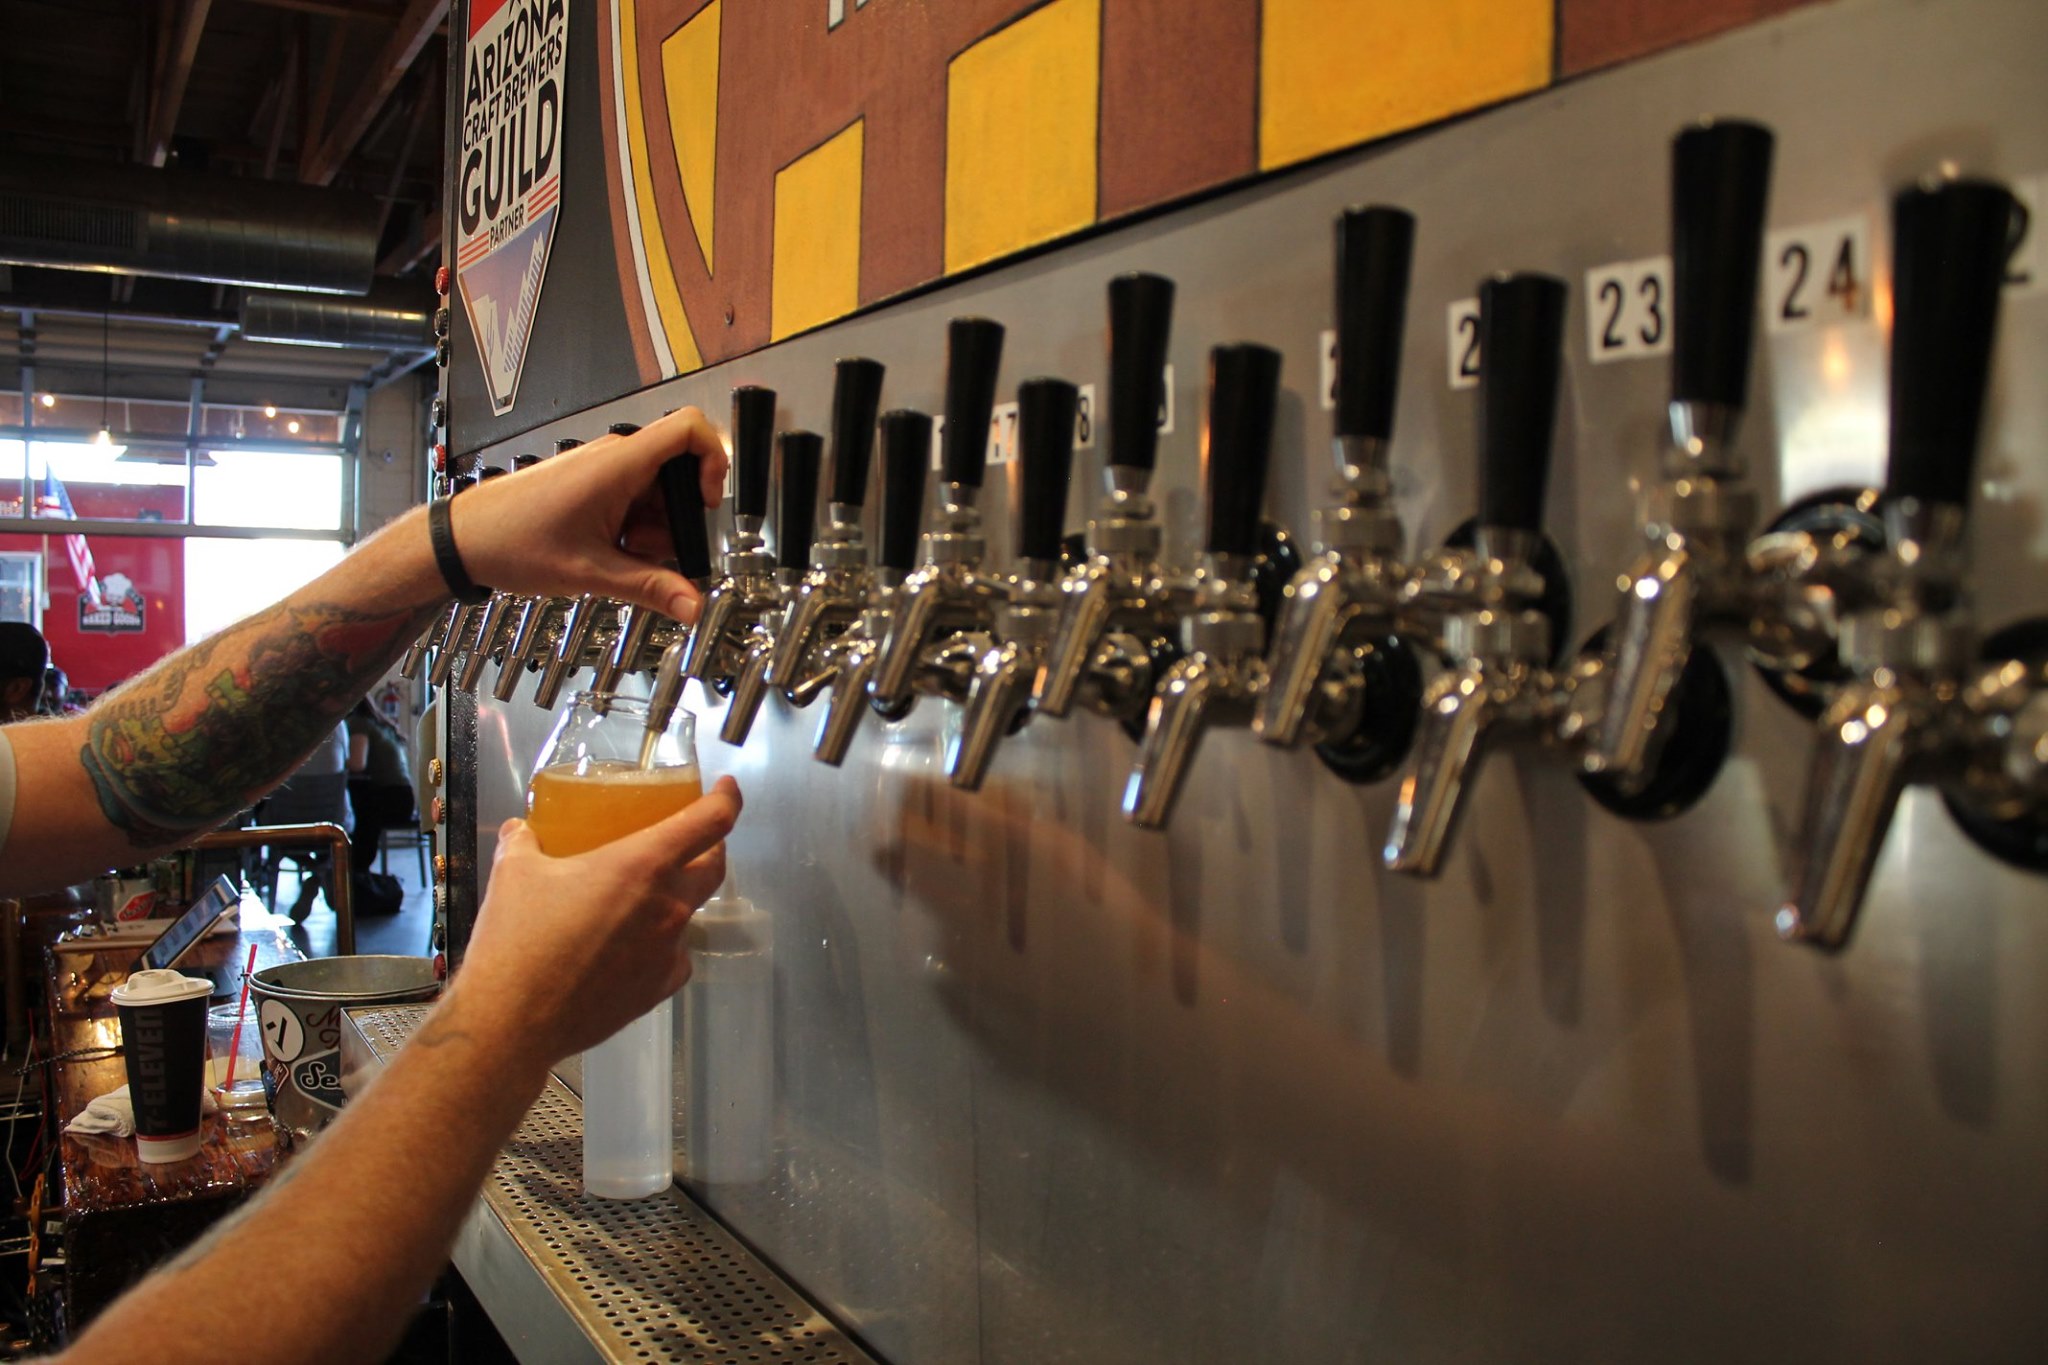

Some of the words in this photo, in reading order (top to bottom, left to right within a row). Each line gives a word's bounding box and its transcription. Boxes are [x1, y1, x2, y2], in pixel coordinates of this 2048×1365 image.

[464, 91, 502, 152] CRAFT
[504, 25, 563, 118] BREWERS
[465, 0, 564, 118] ARIZONA
[461, 78, 558, 236] GUILD
[490, 203, 525, 248] PARTNER
[1600, 275, 1663, 349] 23
[1780, 236, 1859, 320] 24
[1459, 315, 1481, 377] 2
[1078, 396, 1091, 443] 8
[300, 1061, 343, 1089] Se
